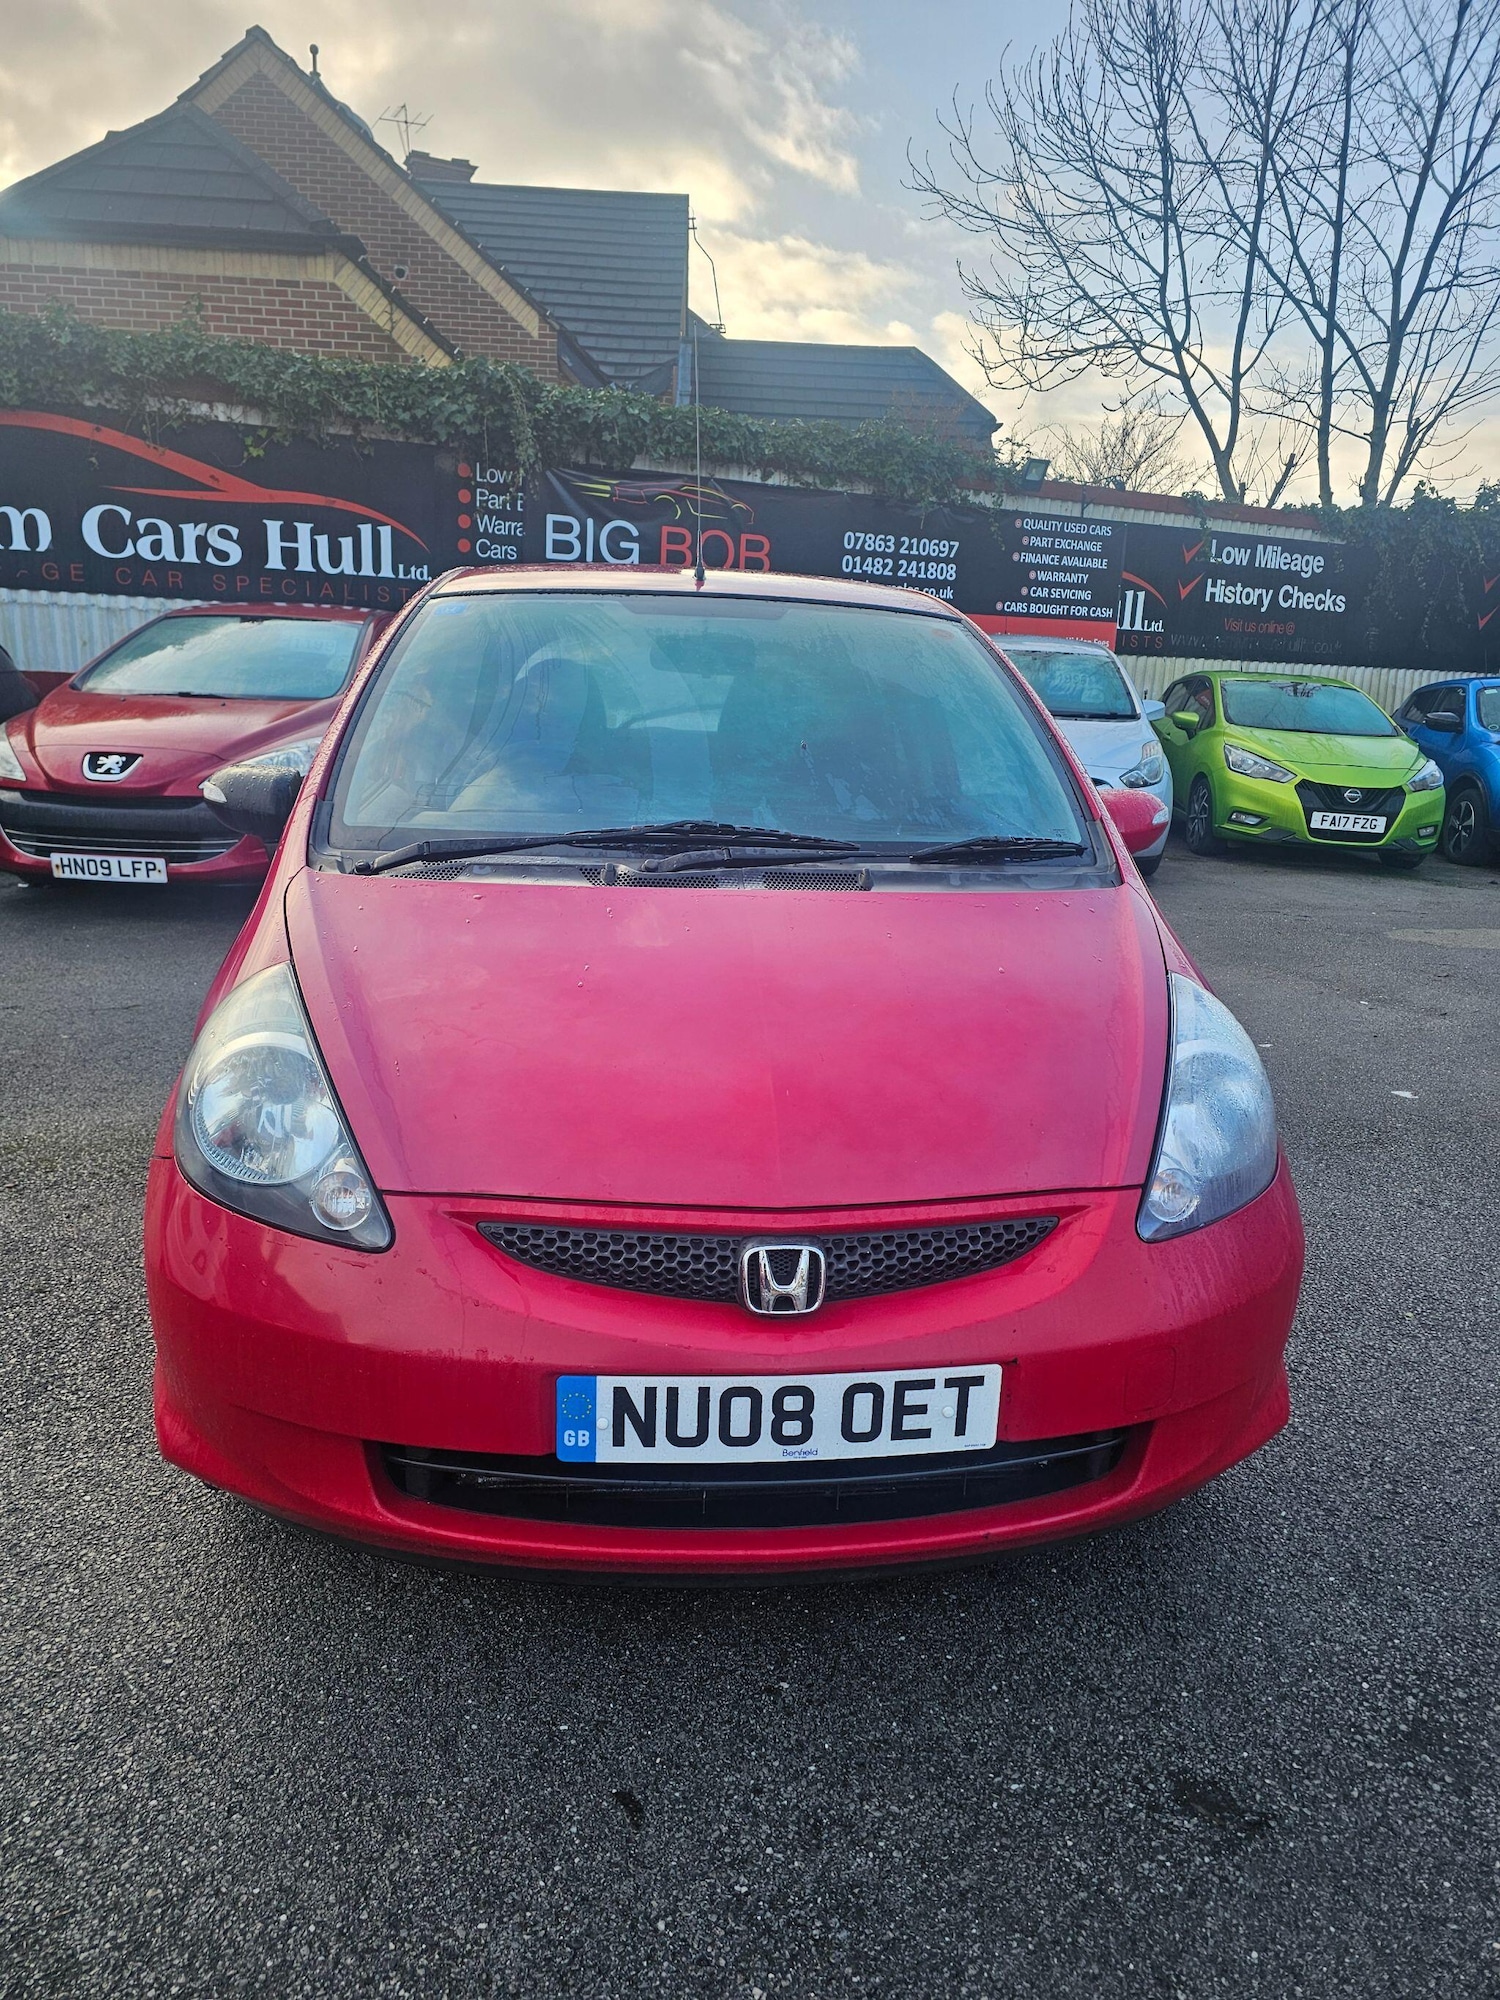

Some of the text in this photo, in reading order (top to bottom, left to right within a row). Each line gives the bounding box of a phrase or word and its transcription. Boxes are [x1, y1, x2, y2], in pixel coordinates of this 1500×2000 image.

[1023, 518, 1112, 536] QUALITY USED CARS
[81, 504, 243, 567] Cars
[262, 519, 395, 578] Hull
[476, 538, 517, 560] Cars
[546, 513, 771, 572] BIG BOB
[843, 531, 960, 558] 07863 210697
[1030, 536, 1102, 552] PART EXCHANGE
[1020, 552, 1108, 569] FINANCE AVALIABLE
[1210, 539, 1325, 578] Low Mileage
[842, 555, 957, 581] 01482 241808
[1037, 570, 1089, 584] WARRANTY
[1030, 586, 1092, 600] CAR SEVICING
[1205, 578, 1346, 613] History Checks
[1004, 601, 1113, 618] CARS BOUGHT FOR CASH
[1144, 619, 1164, 633] Ltd.
[1224, 617, 1243, 632] Visit
[1245, 622, 1256, 632] us
[1320, 814, 1378, 830] FA17 FZG
[60, 857, 157, 878] HN09 LFP
[612, 1385, 815, 1448] NU08
[563, 1429, 590, 1447] GB
